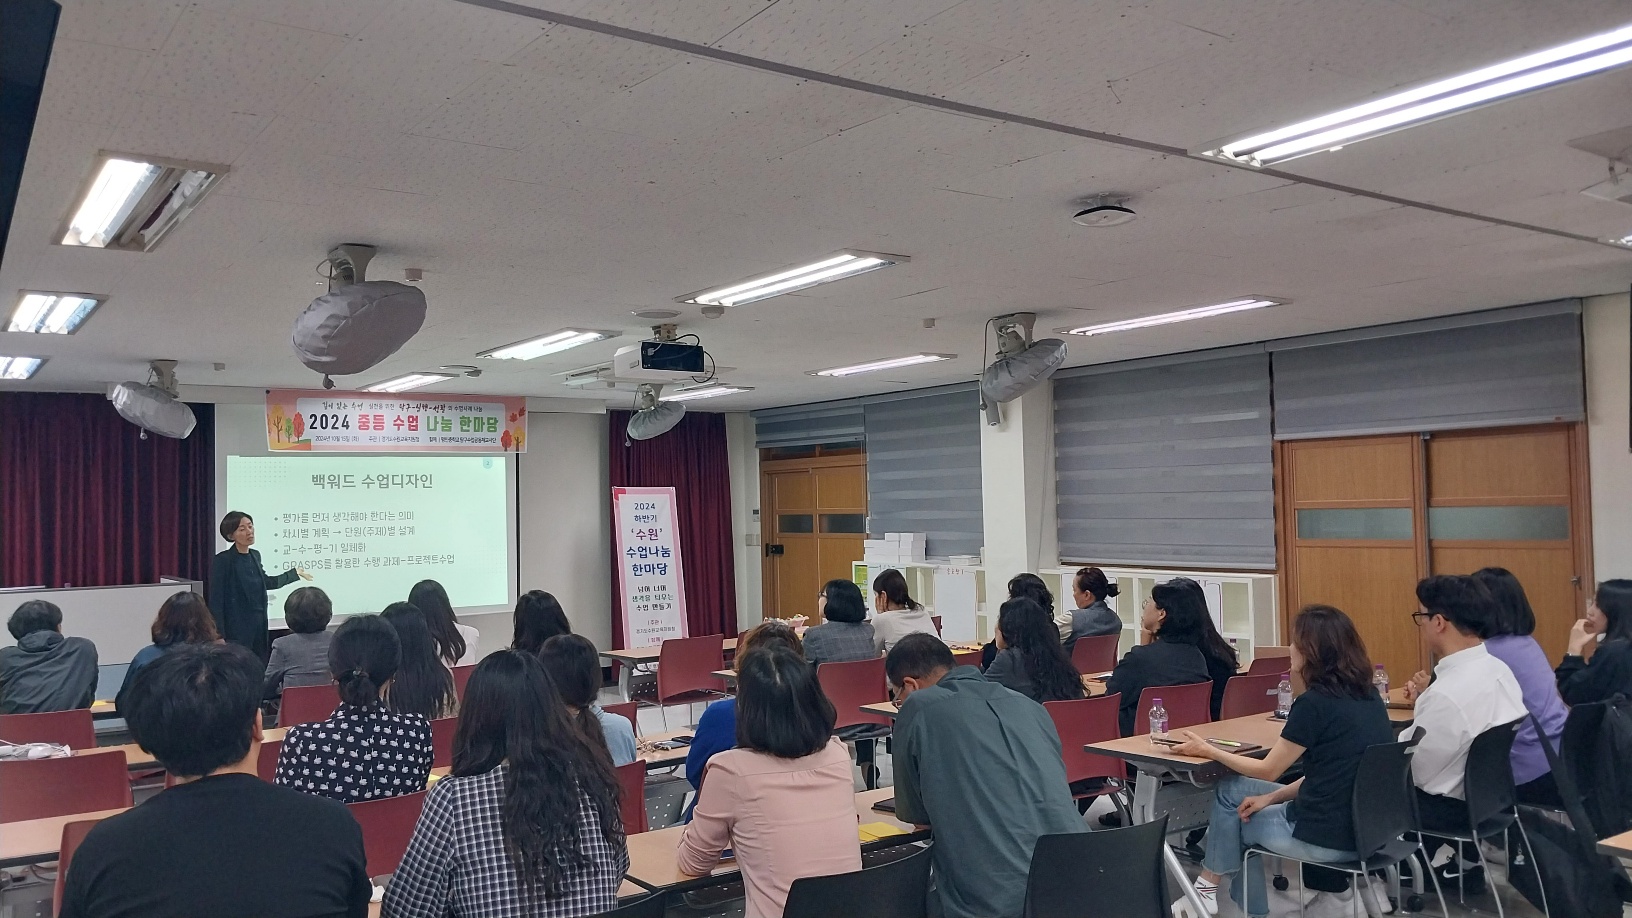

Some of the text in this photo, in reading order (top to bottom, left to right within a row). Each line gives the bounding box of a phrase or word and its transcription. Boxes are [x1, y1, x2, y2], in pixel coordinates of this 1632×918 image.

[351, 402, 364, 411] 수업
[385, 403, 395, 411] 위한
[309, 413, 499, 433] 2024 중등 수업 나눔 한마당
[311, 473, 433, 489] 백워드 수업디자인
[634, 502, 656, 510] 2024
[282, 510, 414, 523] 평가를 먼저 생각해야 한다는 의미
[633, 514, 657, 523] 하반기
[282, 525, 415, 539] 차시별 계획 단원(주제)별 설계
[282, 542, 366, 555] 교-수-평-기 일체화
[626, 545, 671, 559] 수업나눔
[282, 554, 455, 571] GRASPS를 활용한 수행 과제-프로젝트수업
[632, 562, 668, 577] 한마당
[632, 594, 651, 603] 생각을
[652, 602, 672, 611] 만들기
